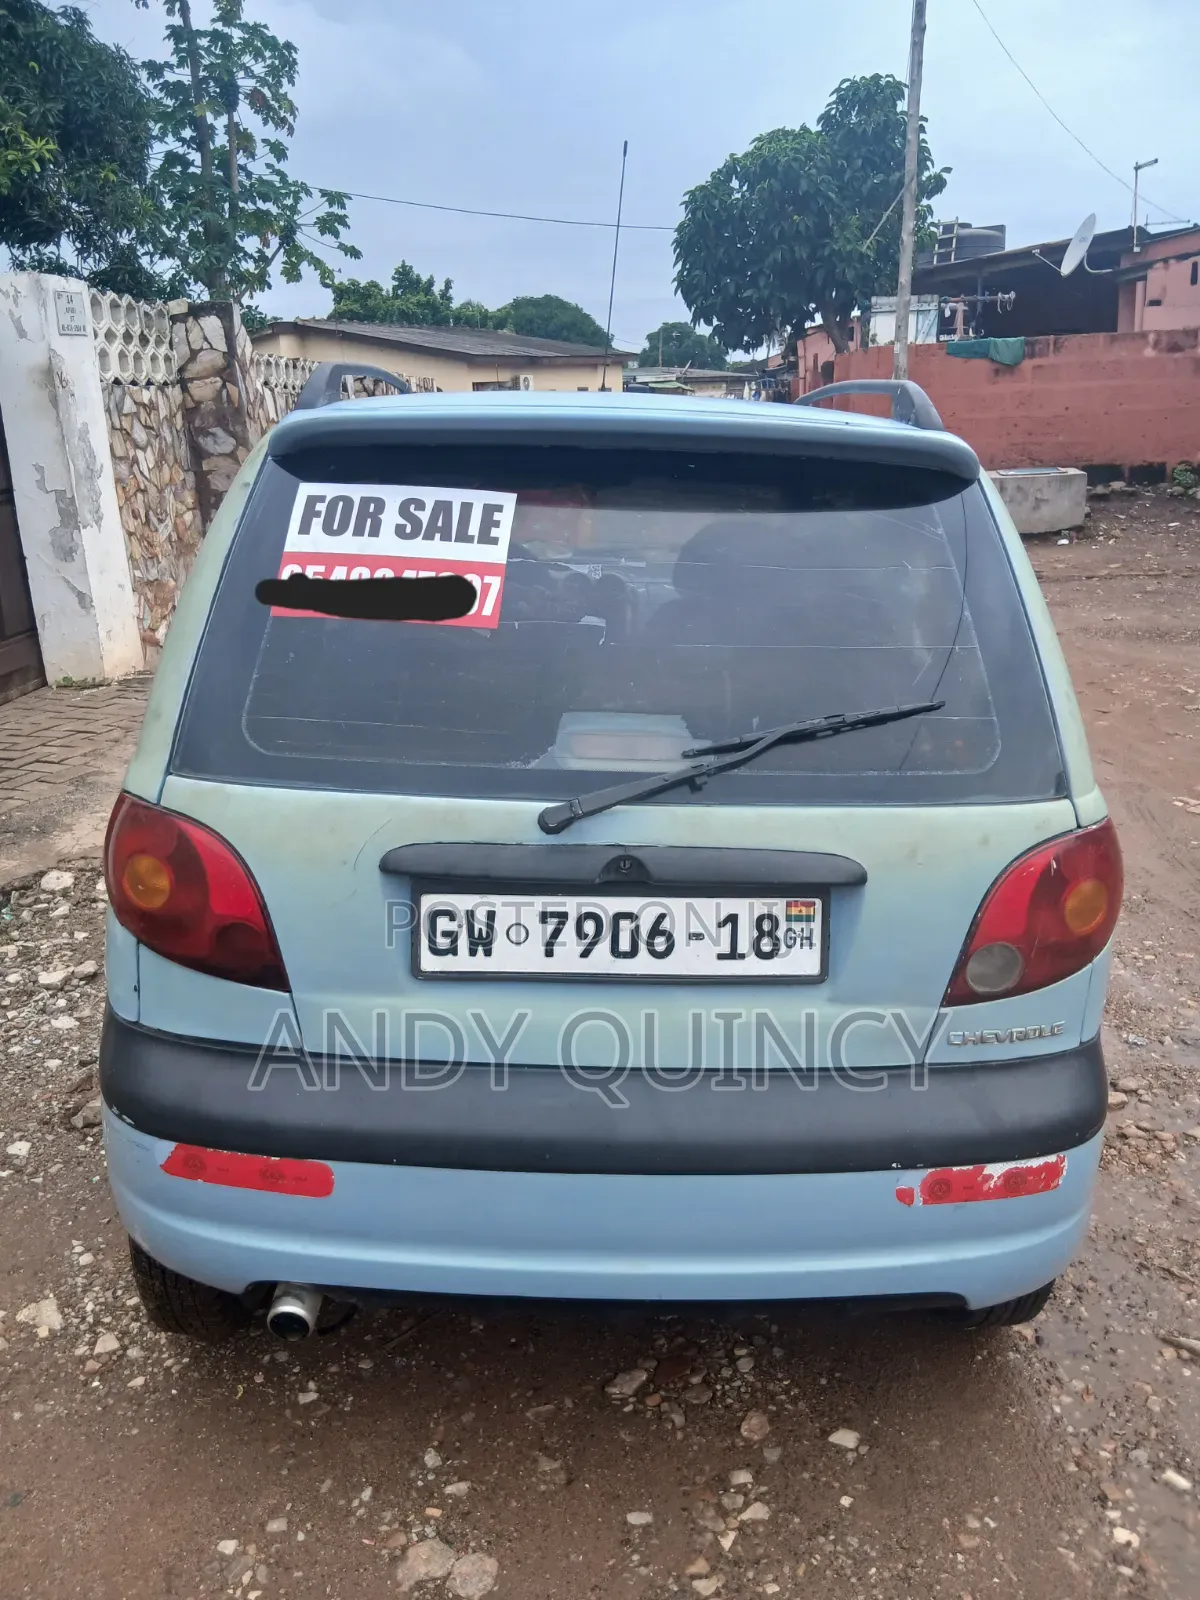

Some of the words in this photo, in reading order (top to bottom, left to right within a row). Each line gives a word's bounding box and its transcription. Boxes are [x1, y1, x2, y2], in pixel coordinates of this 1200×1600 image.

[297, 494, 387, 539] FOR
[394, 497, 505, 546] SALE
[427, 908, 497, 957] GW
[783, 927, 814, 949] GH
